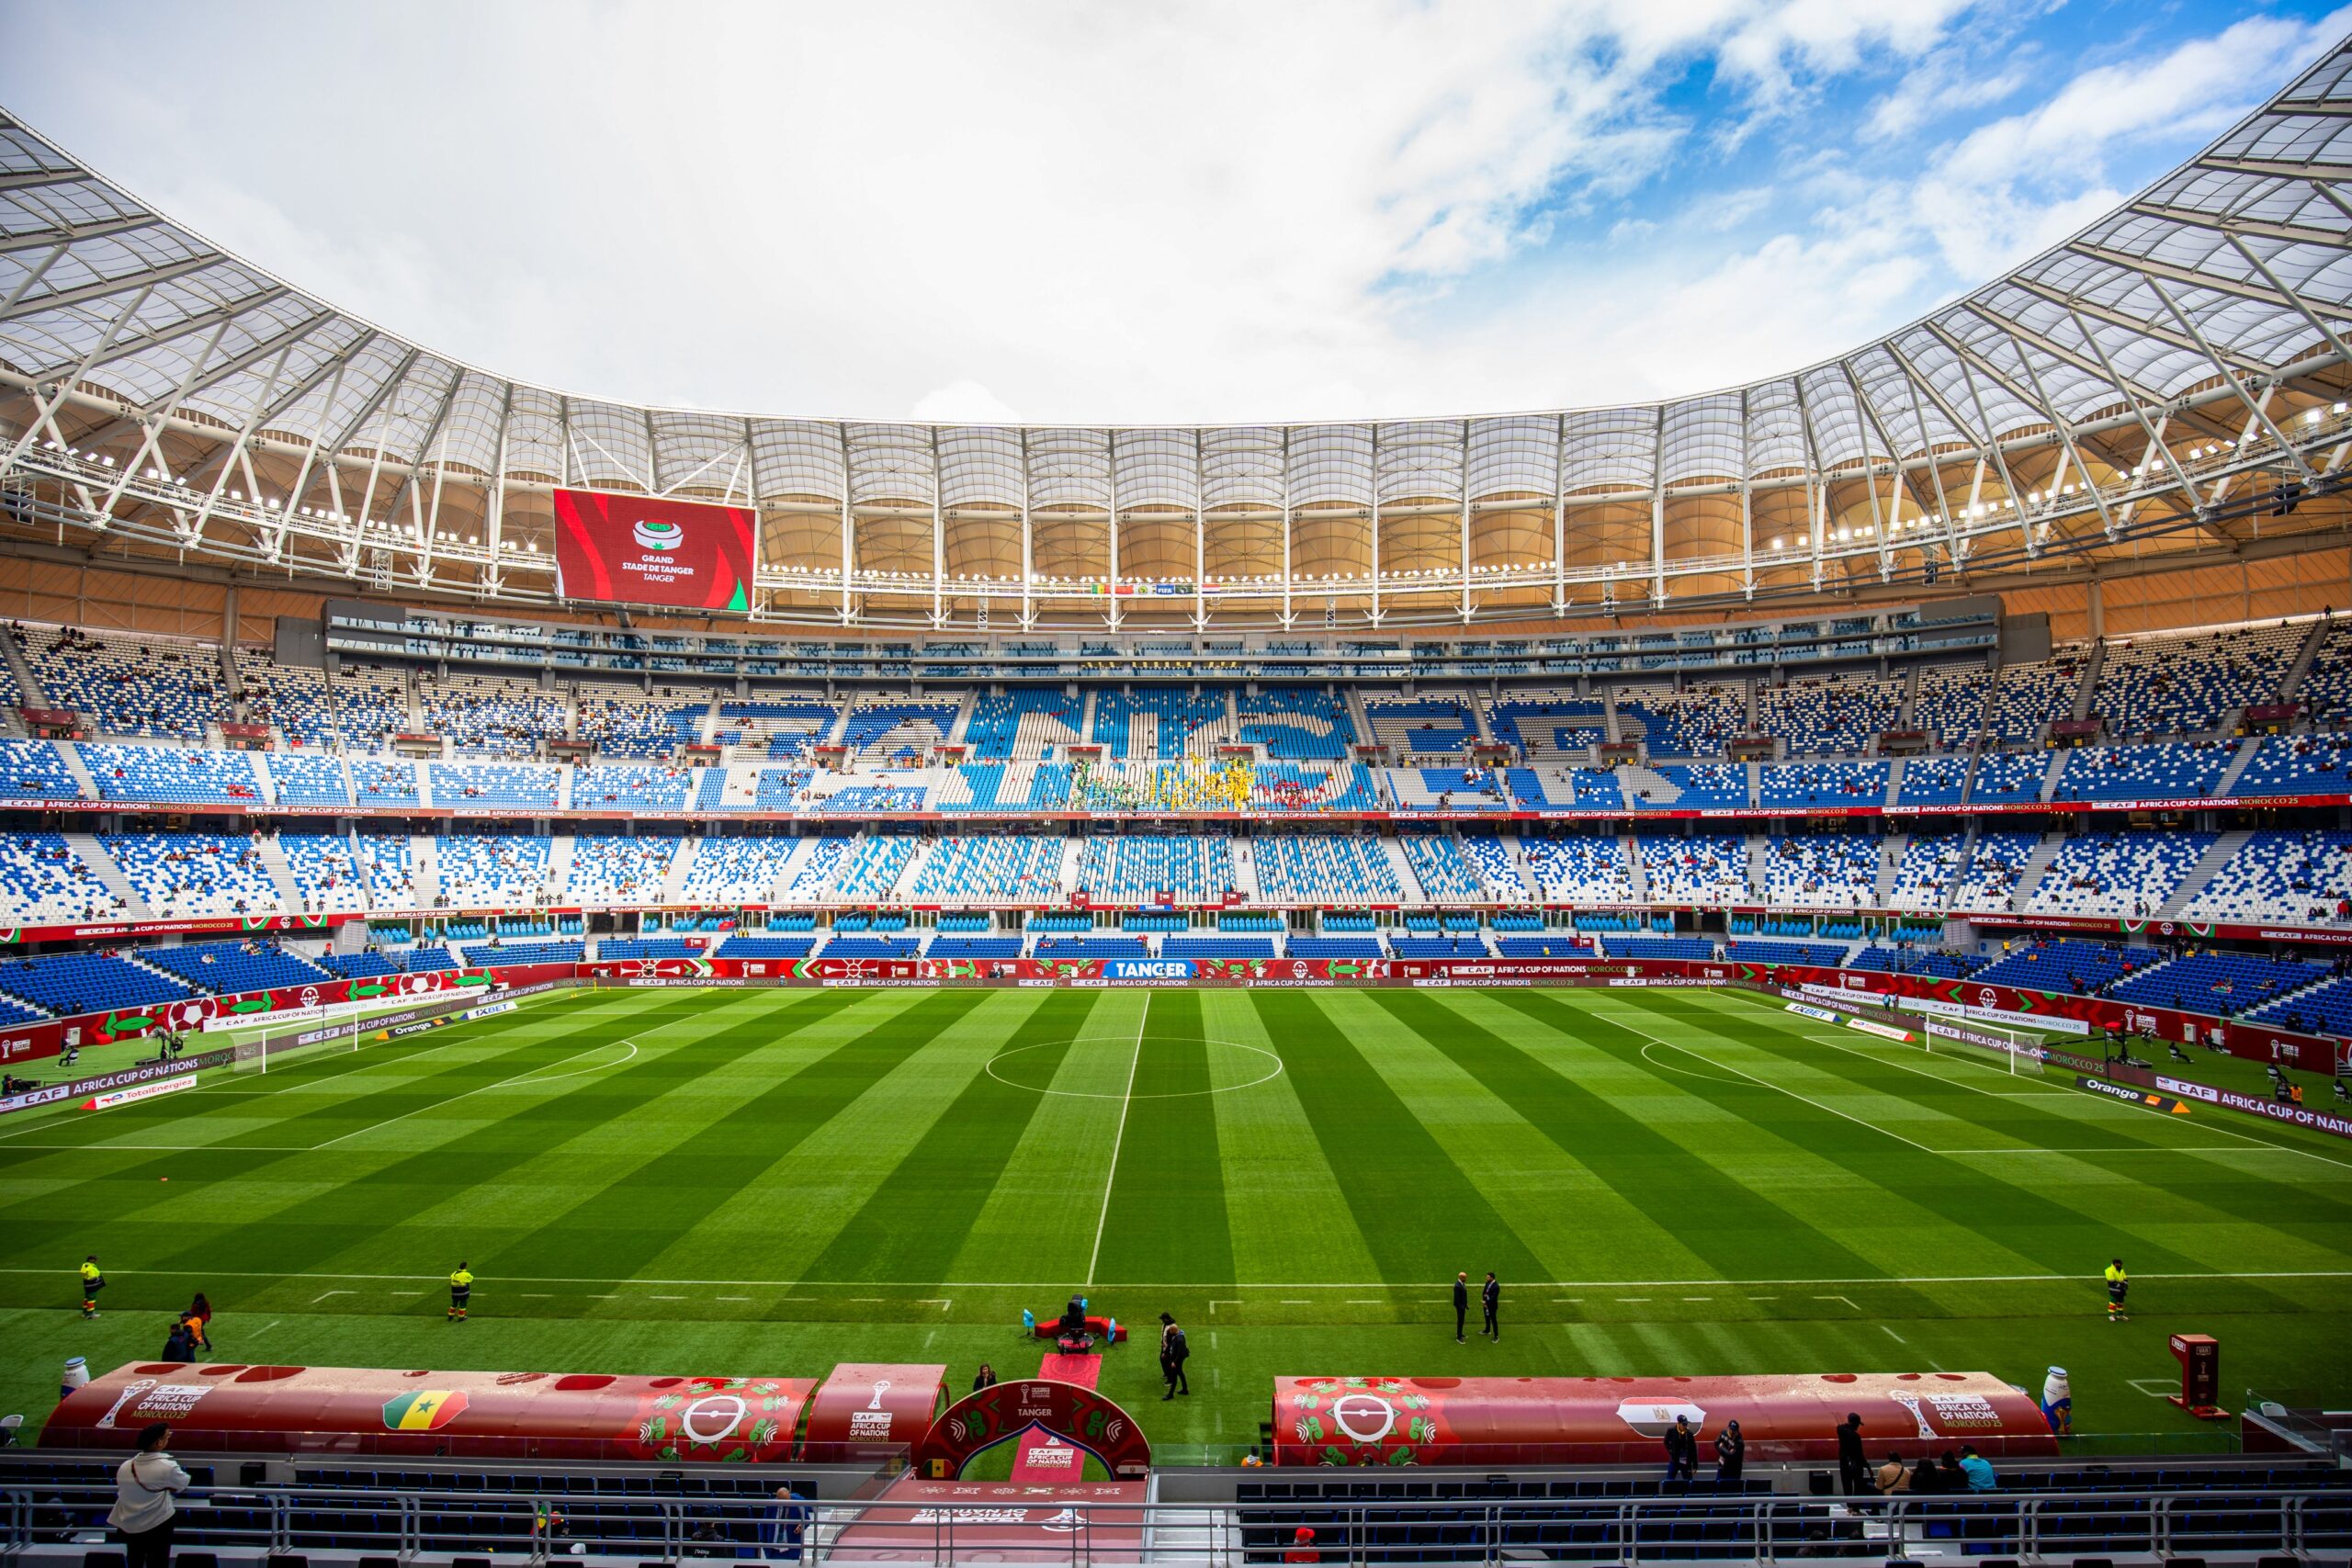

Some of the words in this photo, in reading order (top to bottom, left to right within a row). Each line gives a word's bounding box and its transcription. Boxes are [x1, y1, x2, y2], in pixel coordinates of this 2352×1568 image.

[642, 555, 673, 564] GRAND
[622, 562, 648, 571] STADE
[661, 565, 694, 575] TANGER
[644, 574, 675, 583] TANGER
[1116, 963, 1187, 977] TANGER
[505, 989, 520, 998] AFRICA
[535, 983, 553, 992] NATIONS
[1789, 991, 1802, 999] CAF
[301, 1008, 328, 1017] NATIONS
[476, 1004, 507, 1017] 1XBET
[1965, 1008, 1986, 1017] AFRICA
[2009, 1015, 2036, 1024] NATIONS
[367, 1019, 379, 1029] CUP
[389, 1012, 415, 1024] NATIONS
[395, 1022, 431, 1035] Orange
[1937, 1026, 1955, 1036] CAF
[1962, 1032, 1987, 1045] AFRICA
[1987, 1038, 2001, 1048] CUP
[2094, 1064, 2104, 1072] 25
[25, 1088, 62, 1104] CAF
[73, 1077, 115, 1095] AFRICA
[116, 1073, 138, 1085] CUP
[140, 1069, 154, 1080] OF
[155, 1059, 198, 1075] NATIONS
[127, 1080, 192, 1098] TotalEnergies
[2086, 1079, 2139, 1100] Orange
[2178, 1084, 2211, 1097] CAF
[2222, 1093, 2266, 1113] AFRICA
[2267, 1104, 2294, 1119] CUP
[2295, 1111, 2314, 1124] OF
[154, 1403, 195, 1411] NATIONS
[1940, 1412, 1955, 1420] OF
